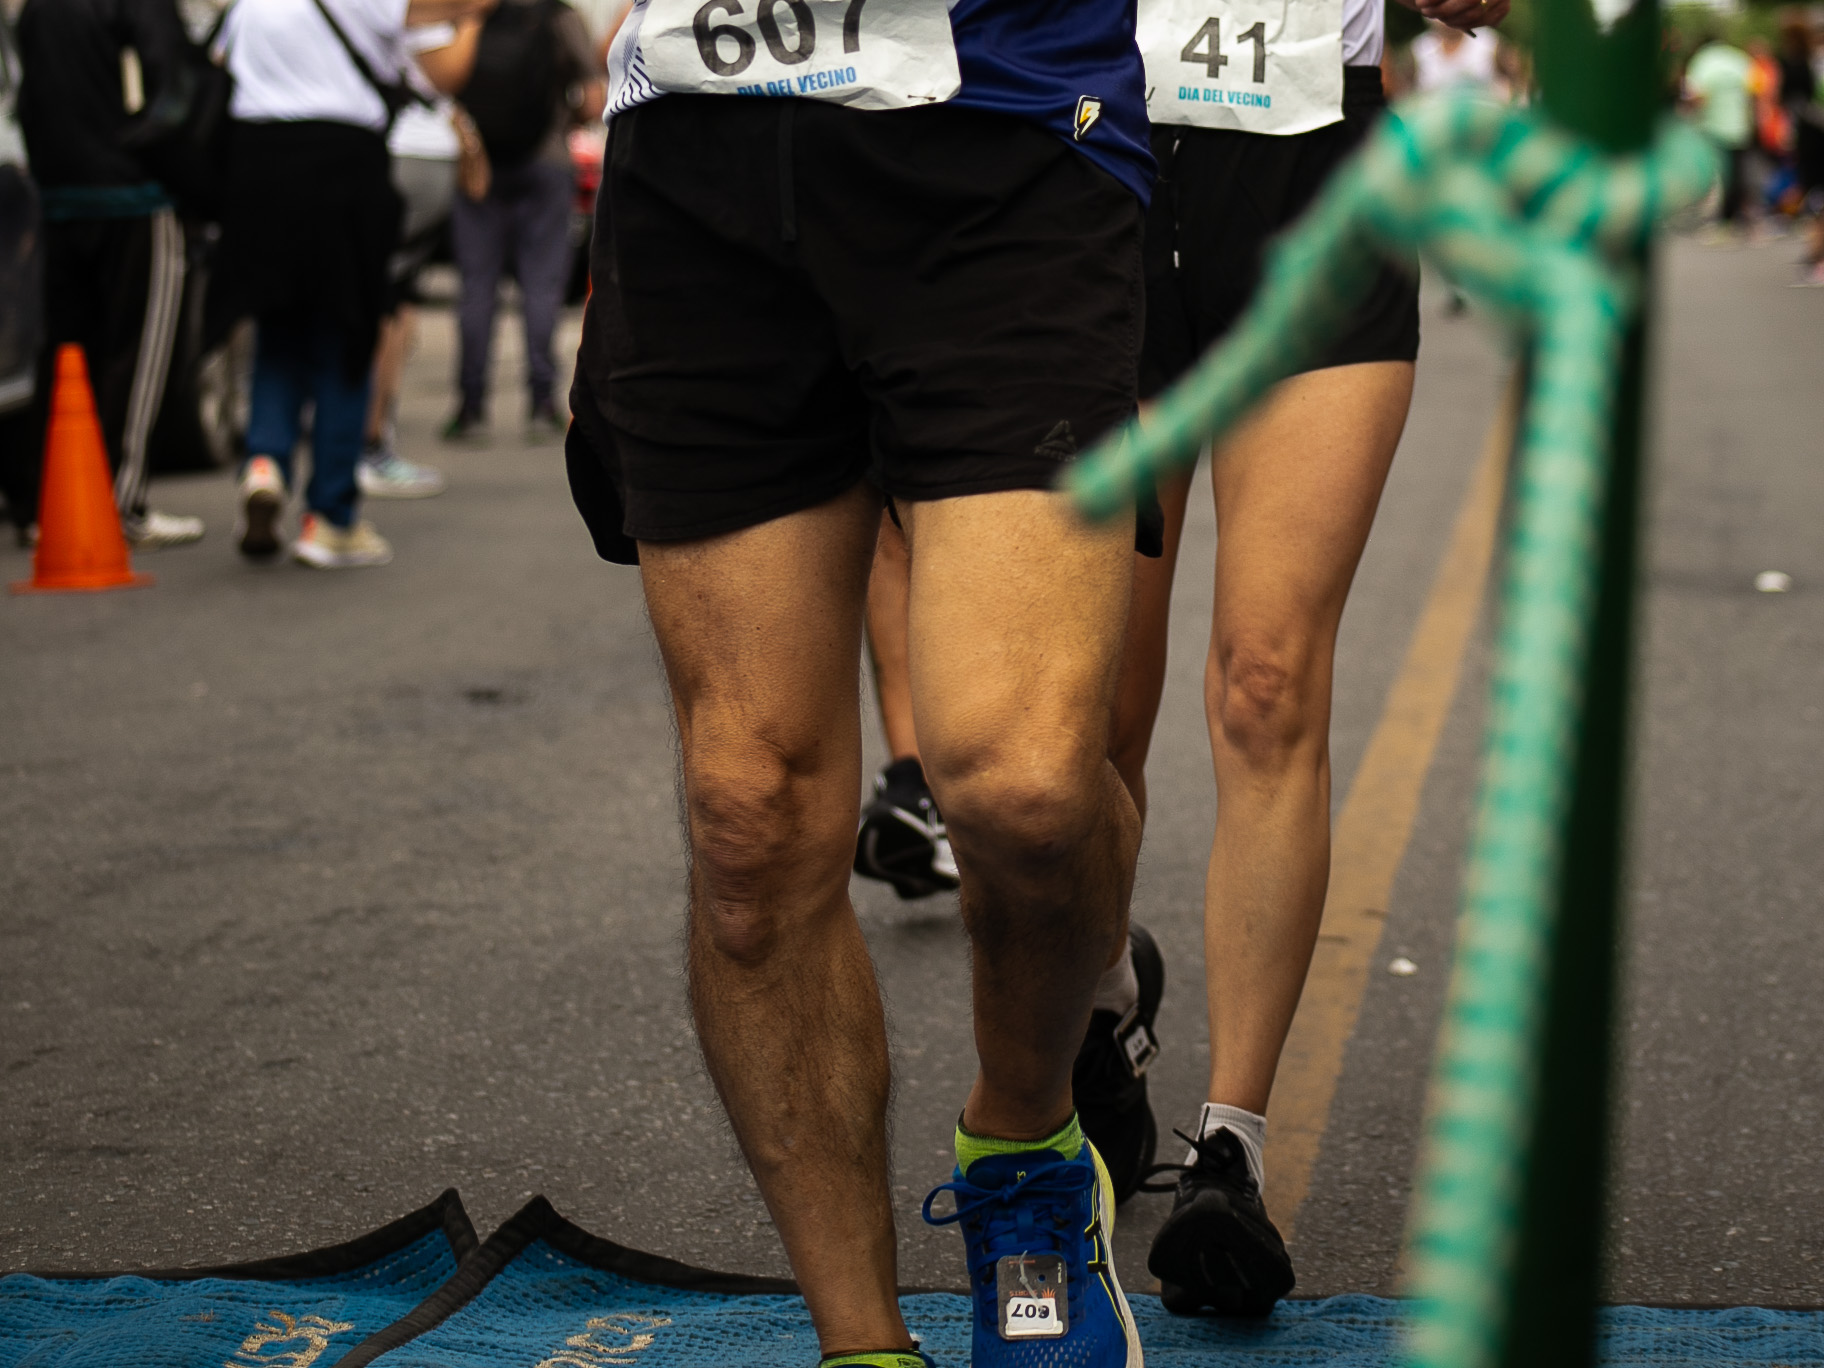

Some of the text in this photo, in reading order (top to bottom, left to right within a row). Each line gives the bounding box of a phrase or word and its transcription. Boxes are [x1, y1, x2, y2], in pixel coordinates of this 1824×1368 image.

[1180, 16, 1267, 84] 41
[766, 78, 796, 97] DEL
[797, 66, 857, 94] VECINO
[1178, 86, 1271, 109] DIA DEL VECINO
[1011, 1303, 1050, 1319] 607
